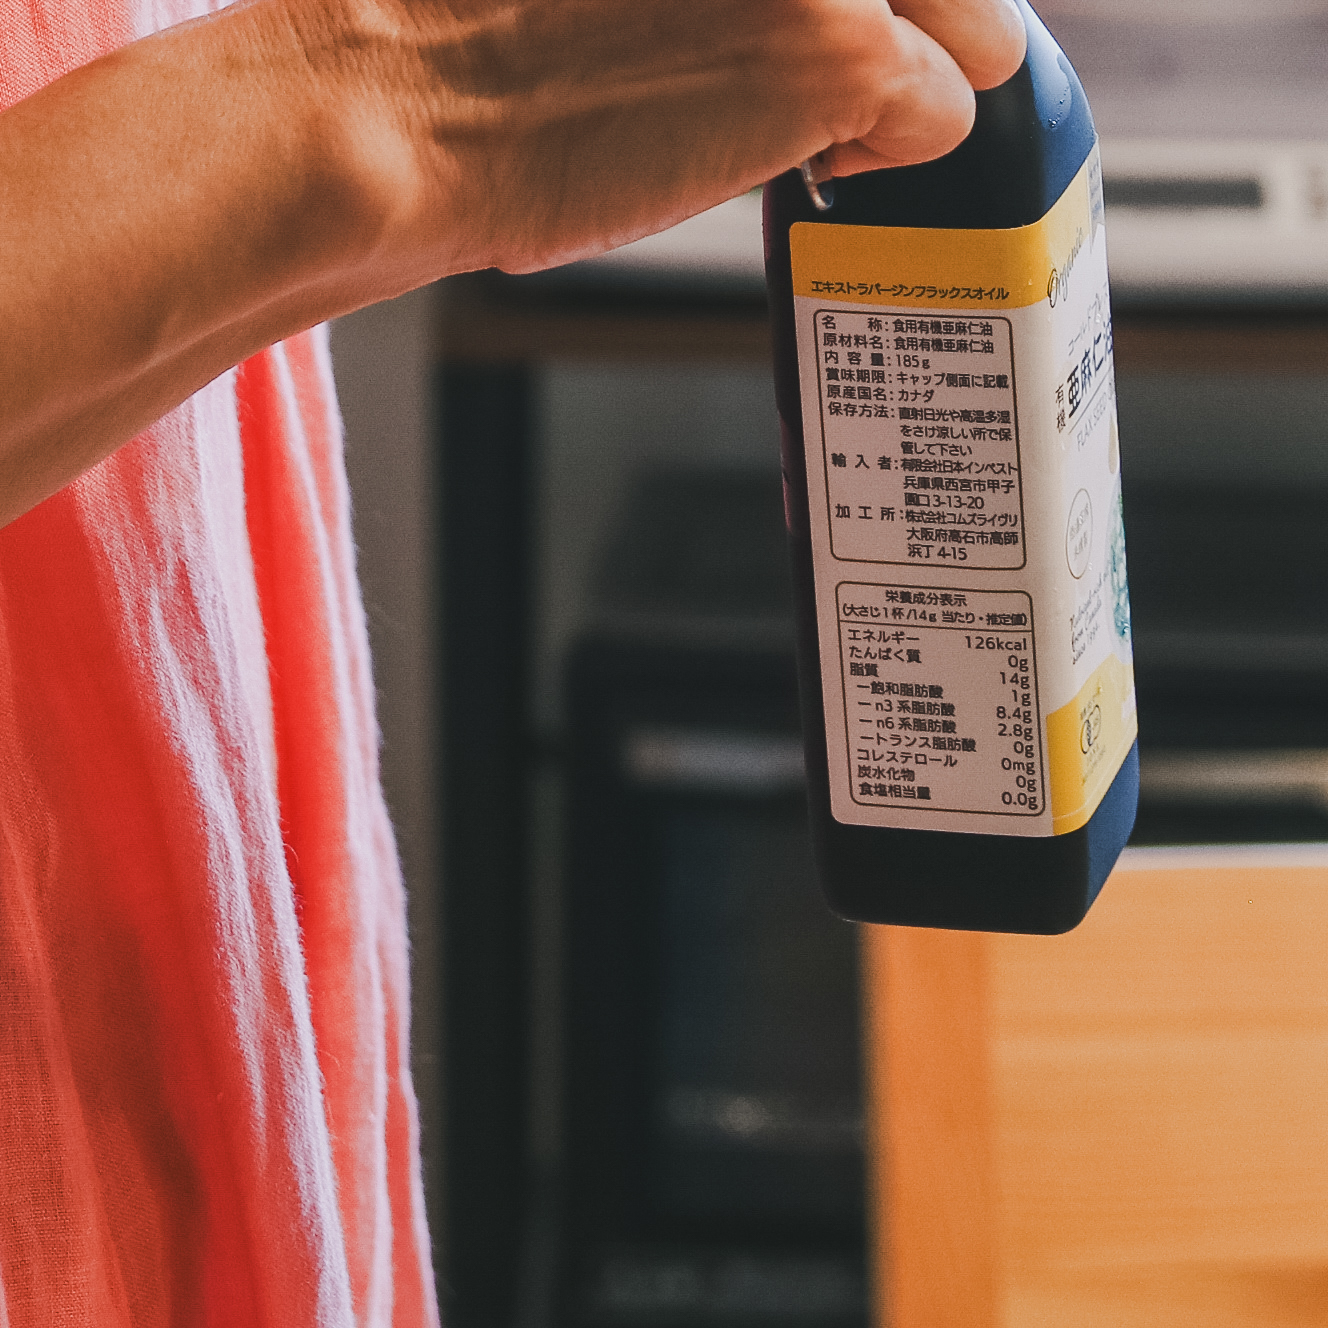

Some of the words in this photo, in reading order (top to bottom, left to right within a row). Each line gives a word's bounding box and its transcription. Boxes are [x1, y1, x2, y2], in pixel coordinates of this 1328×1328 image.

[1048, 227, 1083, 308] Organic
[812, 280, 1010, 301] エキストラバージンフラックスオイル
[893, 320, 993, 336] 食用有機亜麻仁油
[894, 337, 994, 353] 食用有機亜麻仁油
[896, 371, 1008, 389] キャップ側面に記載
[898, 389, 934, 403] カナダ
[899, 408, 1011, 424] 直射日光や高温多湿
[900, 424, 1012, 441] をさけ涼しい所で保
[901, 442, 972, 456] 管して下さい
[903, 476, 1015, 494] 兵庫県西宮市甲子
[907, 528, 1018, 545] 大阪府高石市高師
[886, 590, 966, 607] 栄養成分表示
[848, 629, 920, 643] エネルギー
[965, 636, 1027, 651] 126kcal
[849, 646, 921, 663] たんぱく質
[1008, 655, 1028, 672] 0g
[850, 663, 878, 678] 脂質
[1000, 672, 1030, 689] 14g
[1012, 690, 1031, 705] 1g
[996, 706, 1032, 723] 8.4g
[997, 723, 1033, 740] 2.8g
[1014, 741, 1034, 757] 0g
[857, 748, 957, 768] コレステロール
[1001, 757, 1035, 774] 0mg
[858, 765, 914, 782] 炭水化物
[1016, 774, 1036, 792] 0g
[859, 783, 931, 800] 食塩相当量
[1002, 792, 1038, 810] 0.0g
